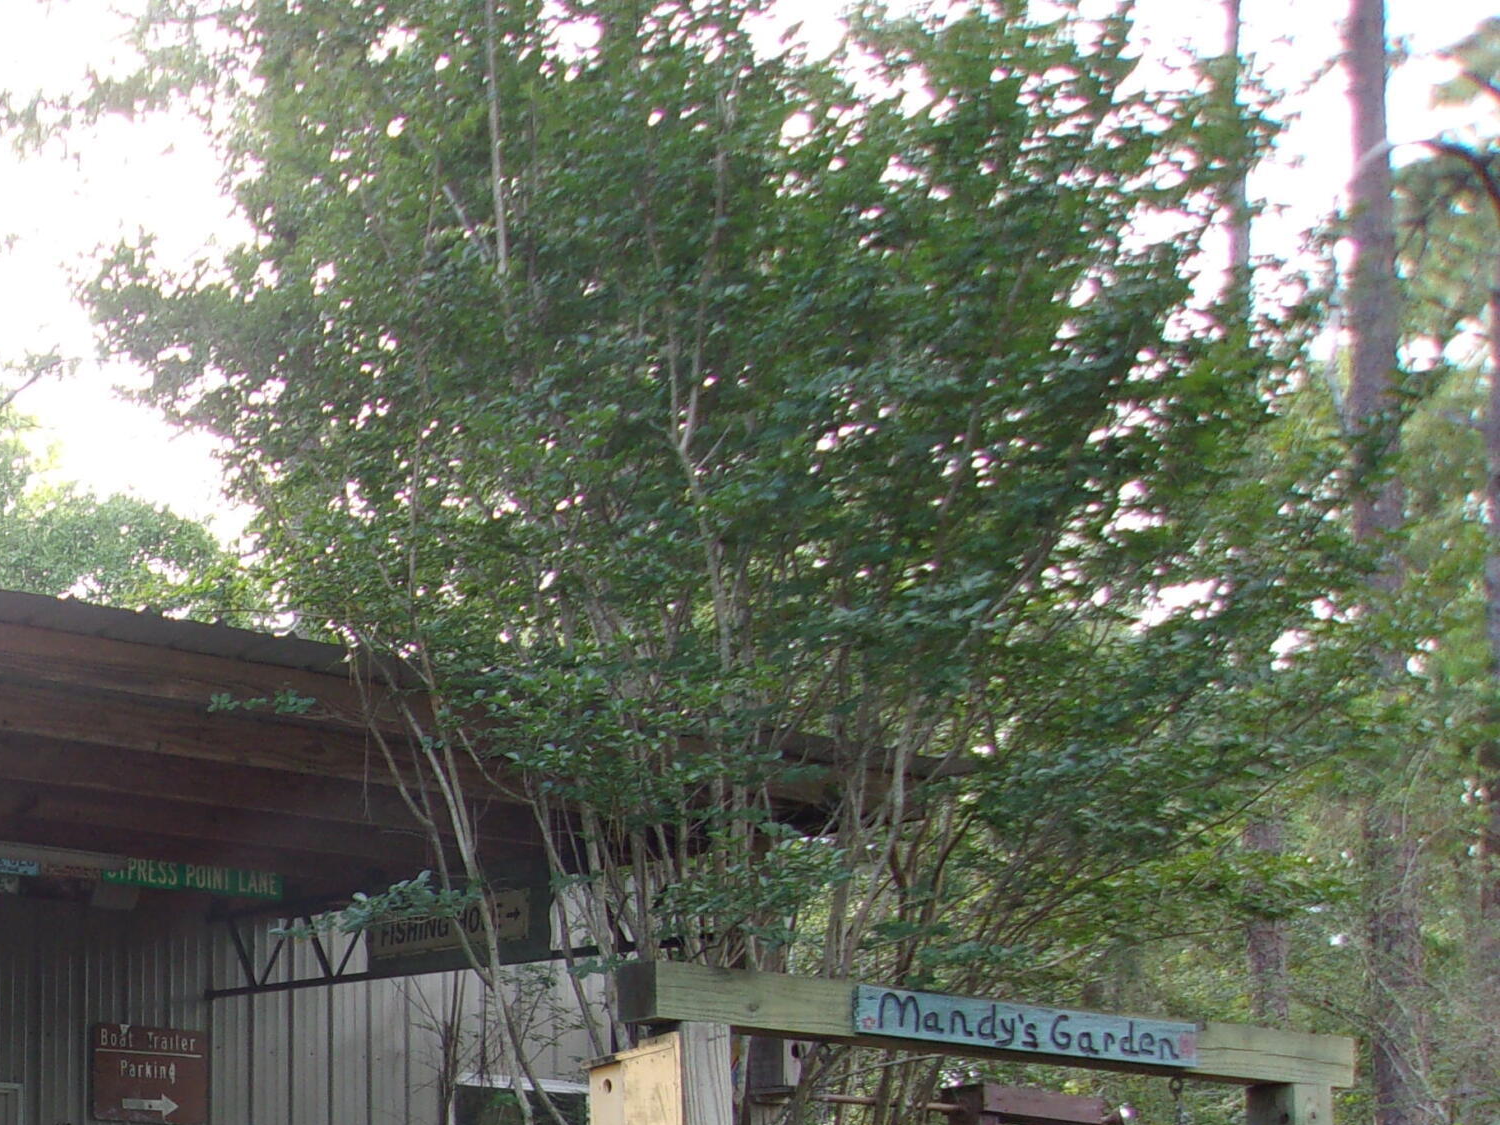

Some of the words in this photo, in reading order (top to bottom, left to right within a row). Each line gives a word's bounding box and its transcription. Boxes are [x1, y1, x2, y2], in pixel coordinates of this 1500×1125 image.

[185, 863, 230, 891] POINT
[238, 869, 278, 896] LANE
[100, 1027, 133, 1049] Boat
[146, 1031, 197, 1052] Trailer
[878, 991, 1038, 1050] Mandy's
[1050, 1014, 1180, 1061] Garden
[120, 1059, 176, 1086] Parking
